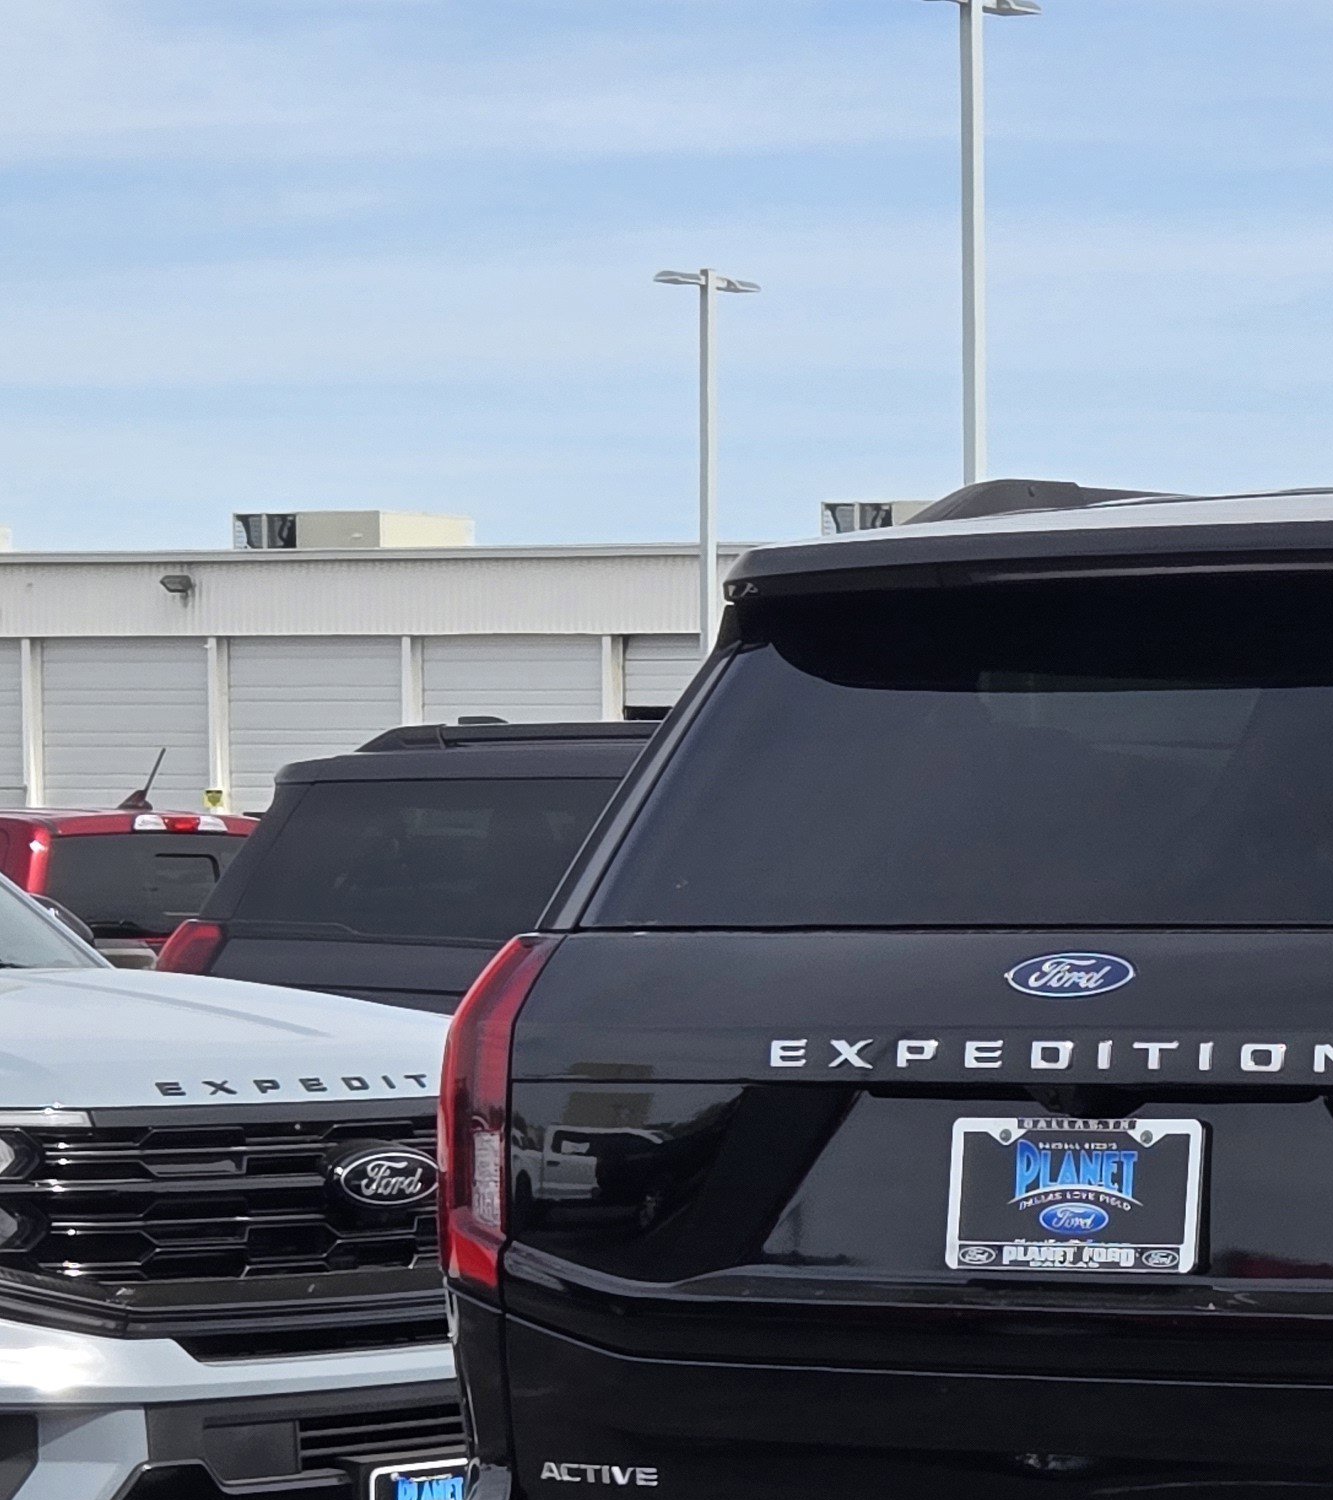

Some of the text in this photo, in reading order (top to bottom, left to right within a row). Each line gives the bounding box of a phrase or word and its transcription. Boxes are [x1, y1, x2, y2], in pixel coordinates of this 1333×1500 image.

[1027, 958, 1104, 991] Ford
[154, 1073, 428, 1097] EXPEDIT
[361, 1161, 423, 1196] Ford
[1015, 1139, 1138, 1198] PLANET
[1052, 1206, 1094, 1229] Ford
[1002, 1246, 1076, 1264] PLANET
[540, 1461, 659, 1487] ACTIVE
